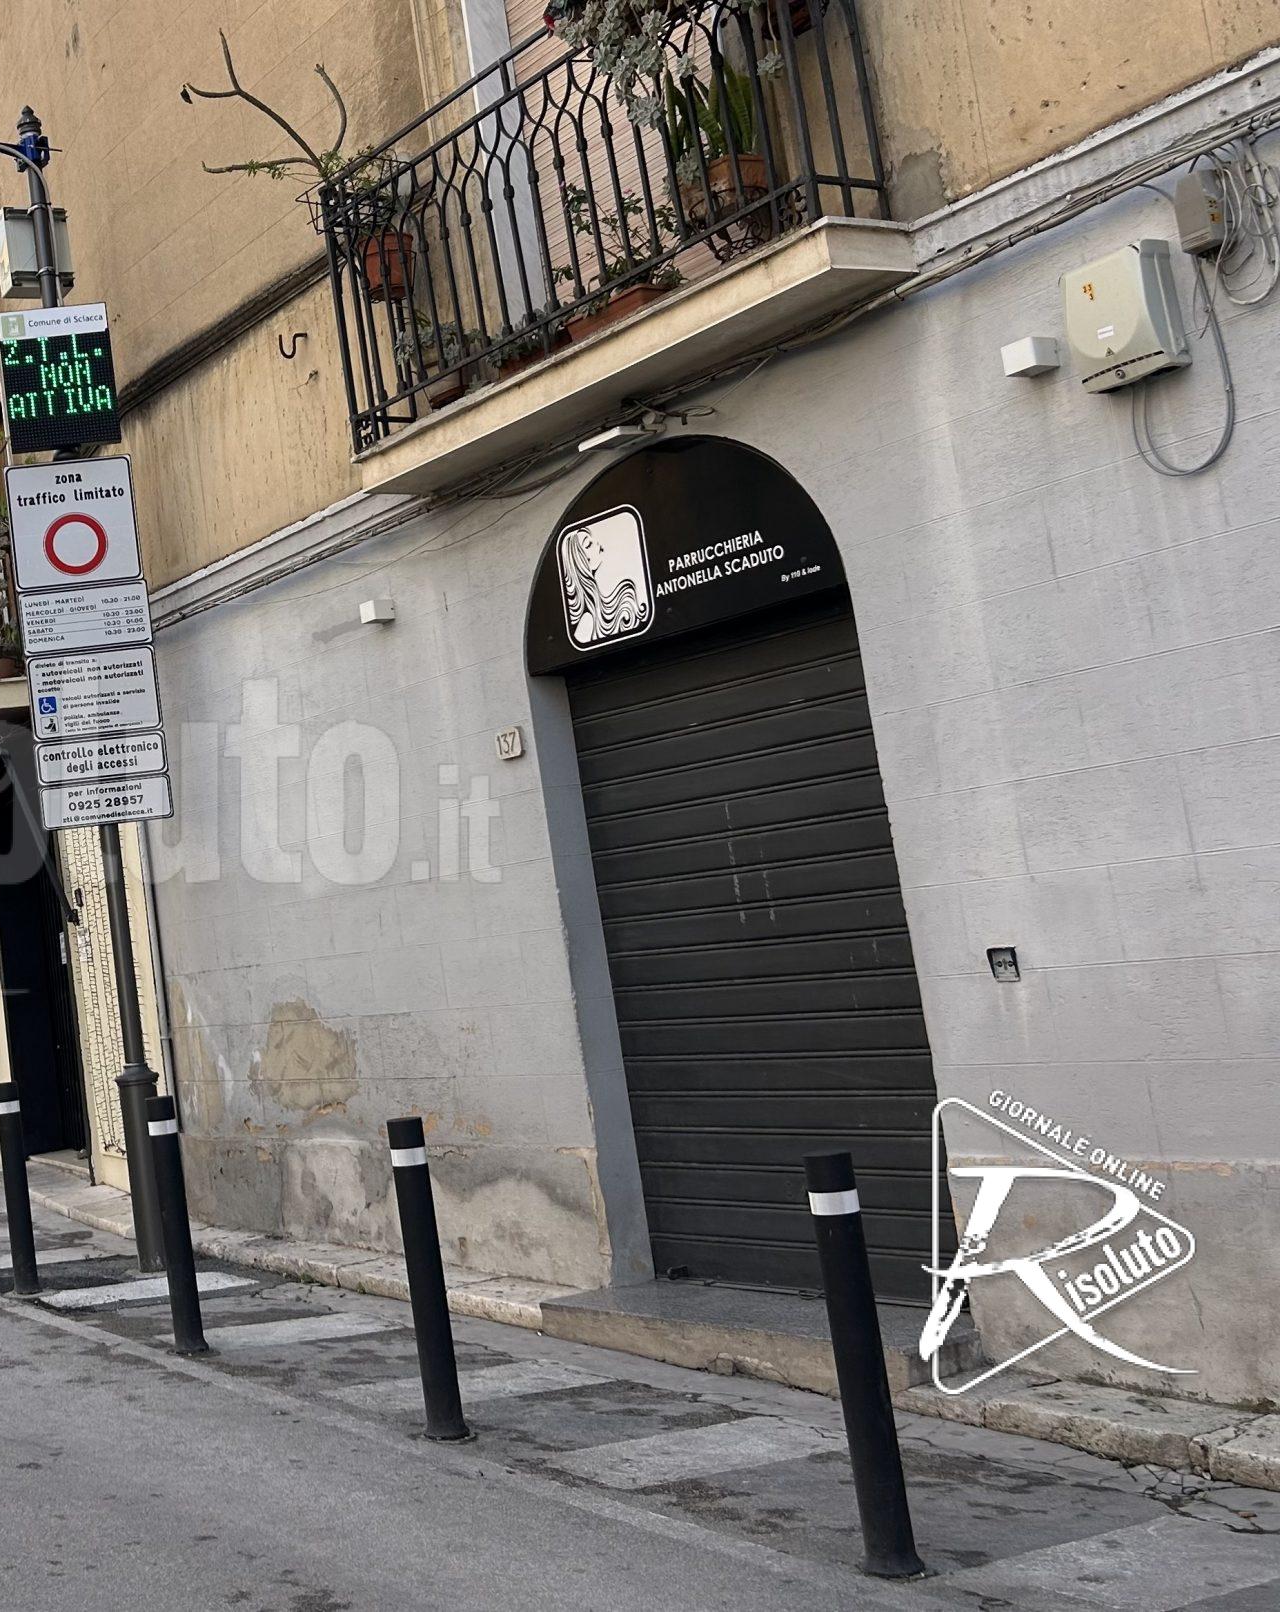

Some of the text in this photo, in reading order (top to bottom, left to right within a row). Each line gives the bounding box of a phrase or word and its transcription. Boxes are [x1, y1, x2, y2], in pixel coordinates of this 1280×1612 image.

[28, 314, 104, 328] Comune di Sciacca
[40, 359, 92, 389] NON
[8, 384, 113, 420] ATTIVA
[55, 472, 83, 485] zona
[17, 486, 125, 507] traffico limitato
[668, 530, 764, 573] PARRUCCHIERIA
[656, 545, 785, 598] ANTONELLA SCADUTO
[780, 573, 790, 583] By
[28, 635, 65, 645] DOMENICA
[86, 665, 101, 673] non
[103, 660, 143, 671] autorizzati
[42, 676, 86, 687] motoveicoli
[88, 674, 102, 682] non
[104, 669, 144, 680] autorizzati
[42, 741, 159, 762] controllo elettronico
[496, 730, 516, 756] 137
[66, 756, 138, 774] degli accessi
[67, 782, 143, 799] per informazioni
[68, 794, 144, 811] 0925 28957
